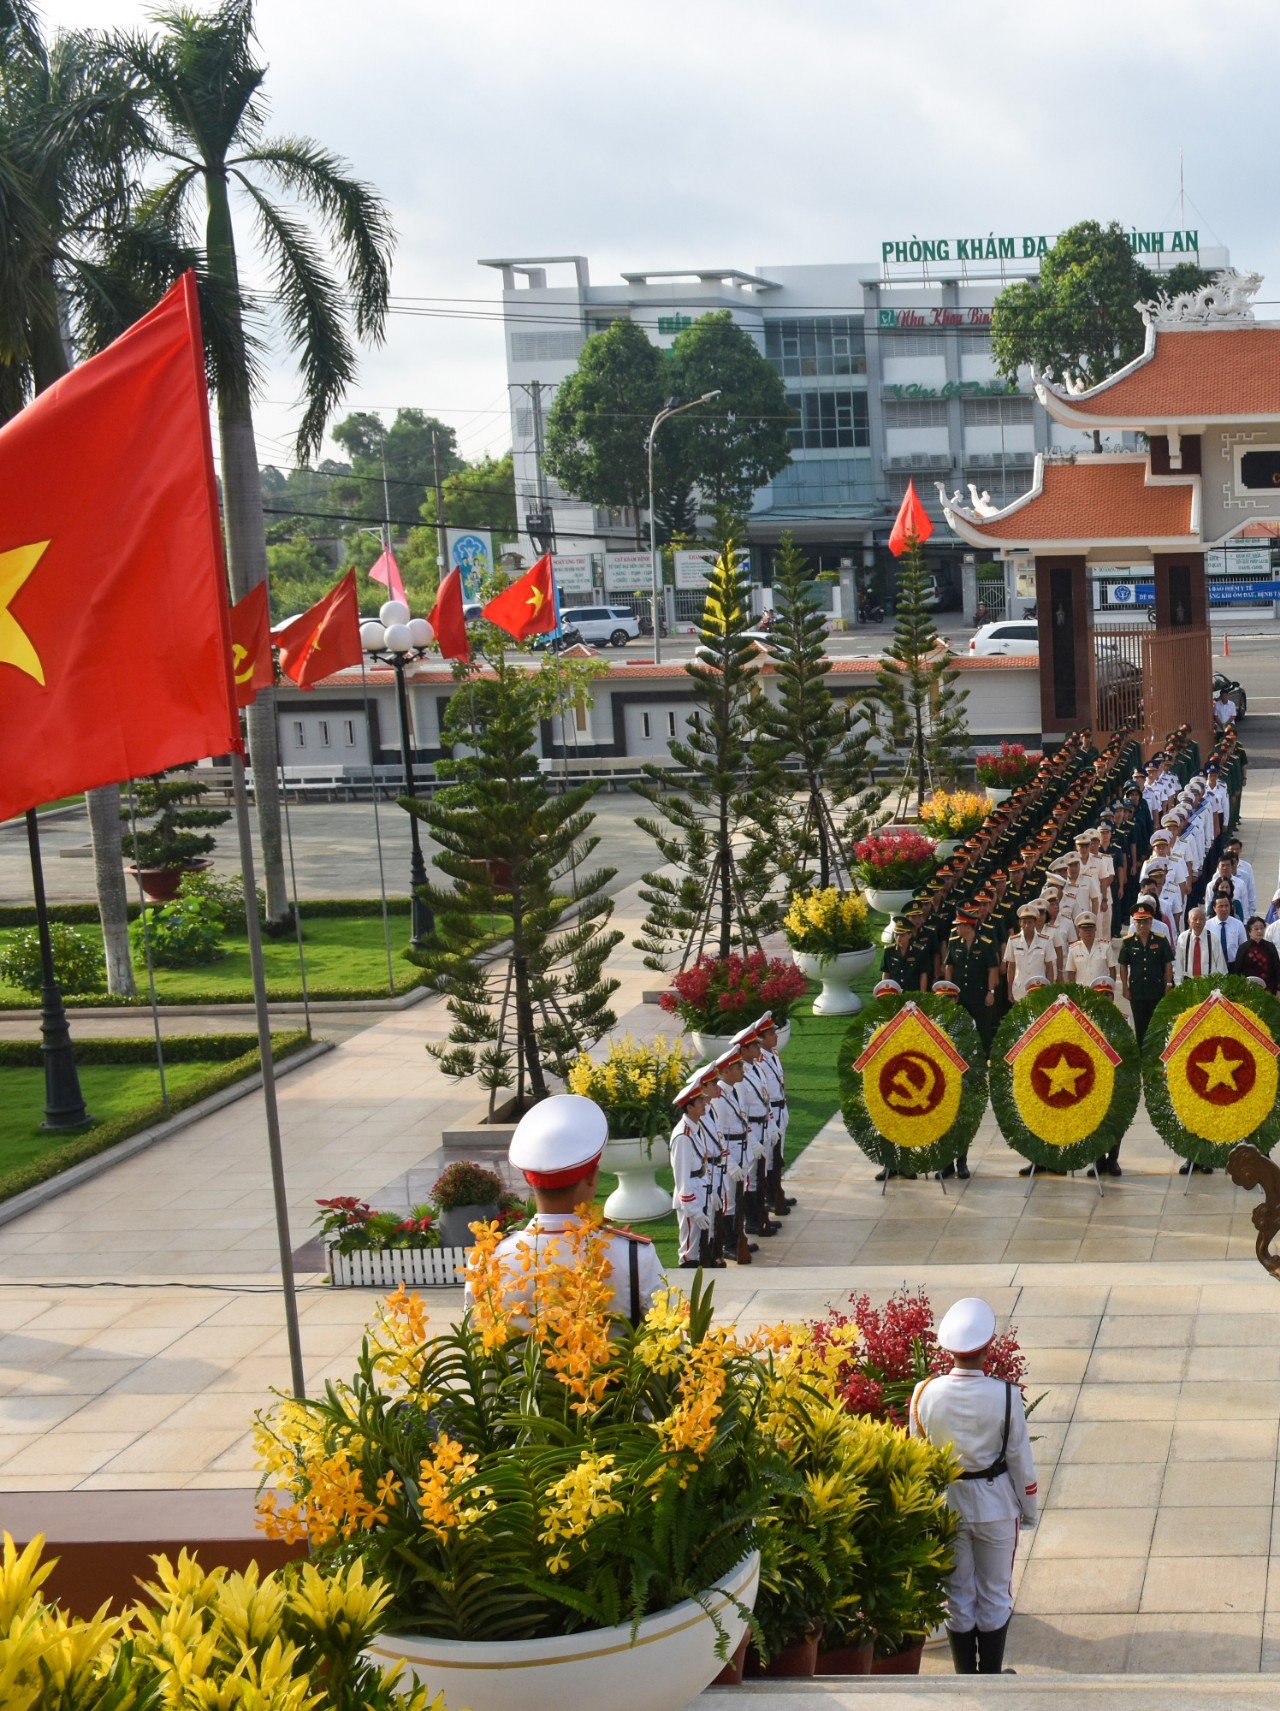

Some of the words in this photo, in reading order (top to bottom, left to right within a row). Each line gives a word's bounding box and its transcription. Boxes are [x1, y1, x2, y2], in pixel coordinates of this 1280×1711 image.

[882, 234, 949, 263] PHÒNG
[956, 232, 1015, 260] KHÁM
[1022, 236, 1048, 258] ĐA
[1171, 230, 1199, 252] AN
